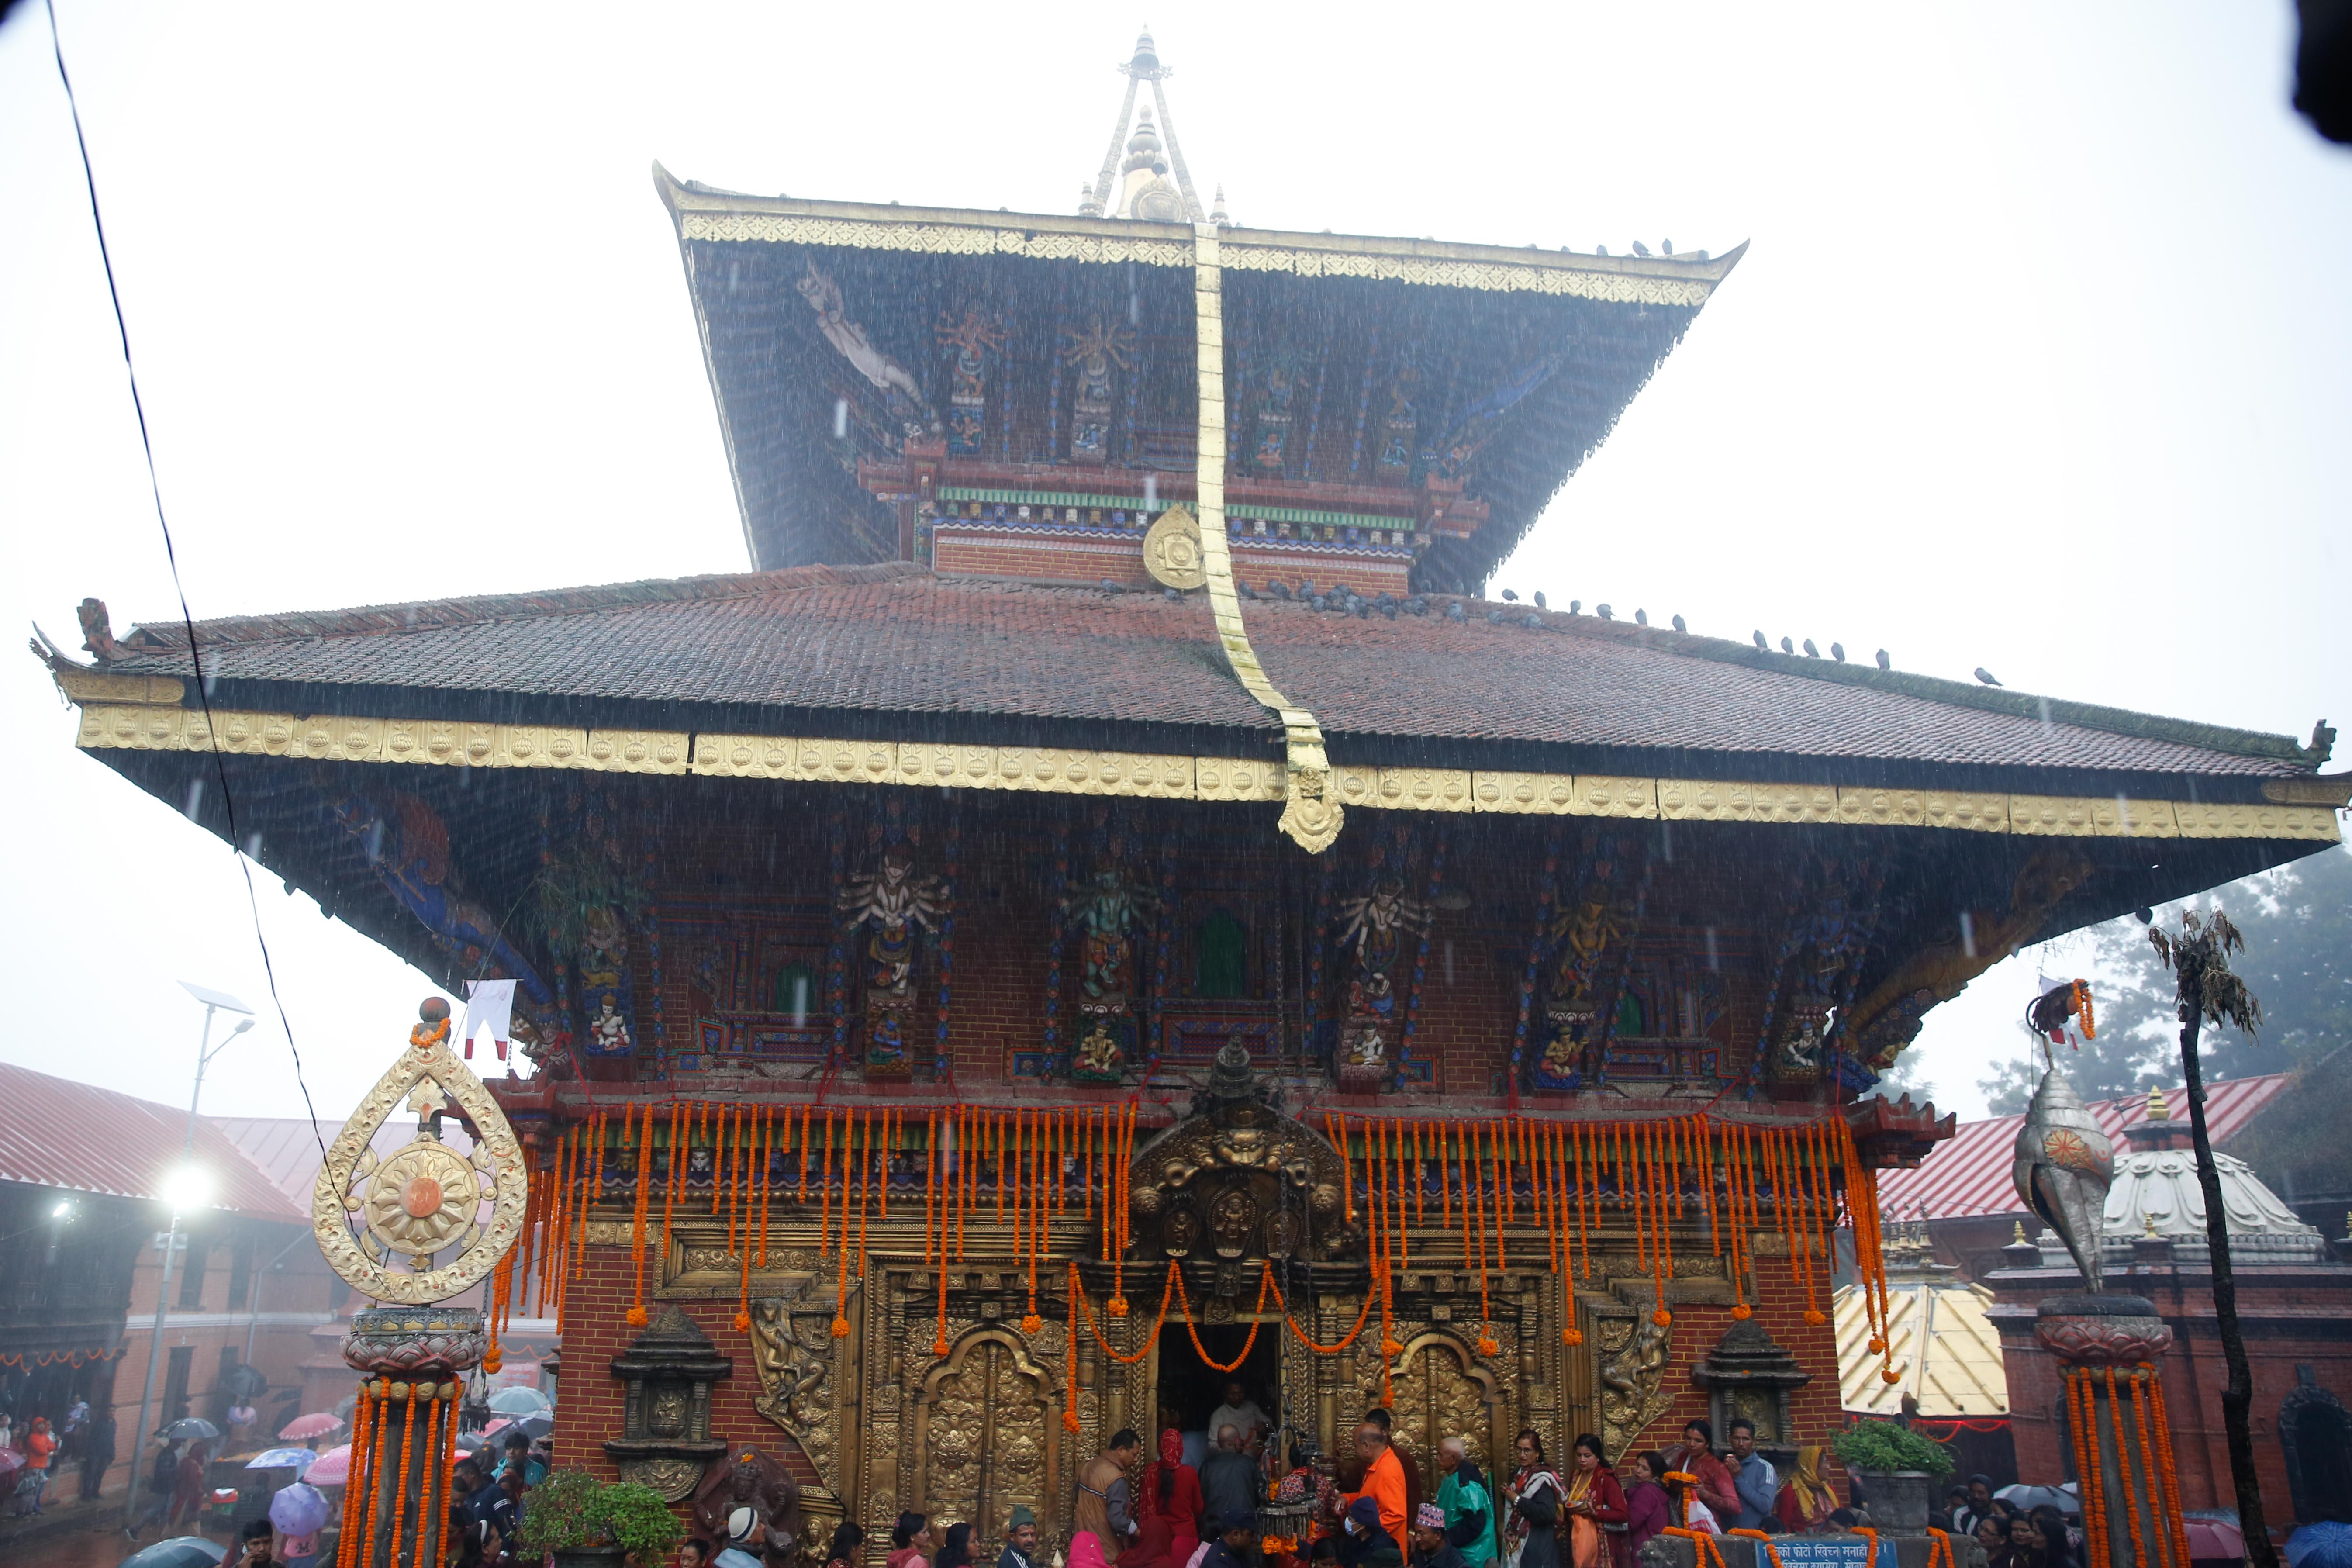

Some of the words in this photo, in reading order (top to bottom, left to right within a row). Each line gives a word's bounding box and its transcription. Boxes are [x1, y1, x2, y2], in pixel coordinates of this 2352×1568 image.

[1792, 1544, 1811, 1558] फोटो
[1813, 1544, 1839, 1558] खिच्न
[1842, 1544, 1868, 1557] मनाही
